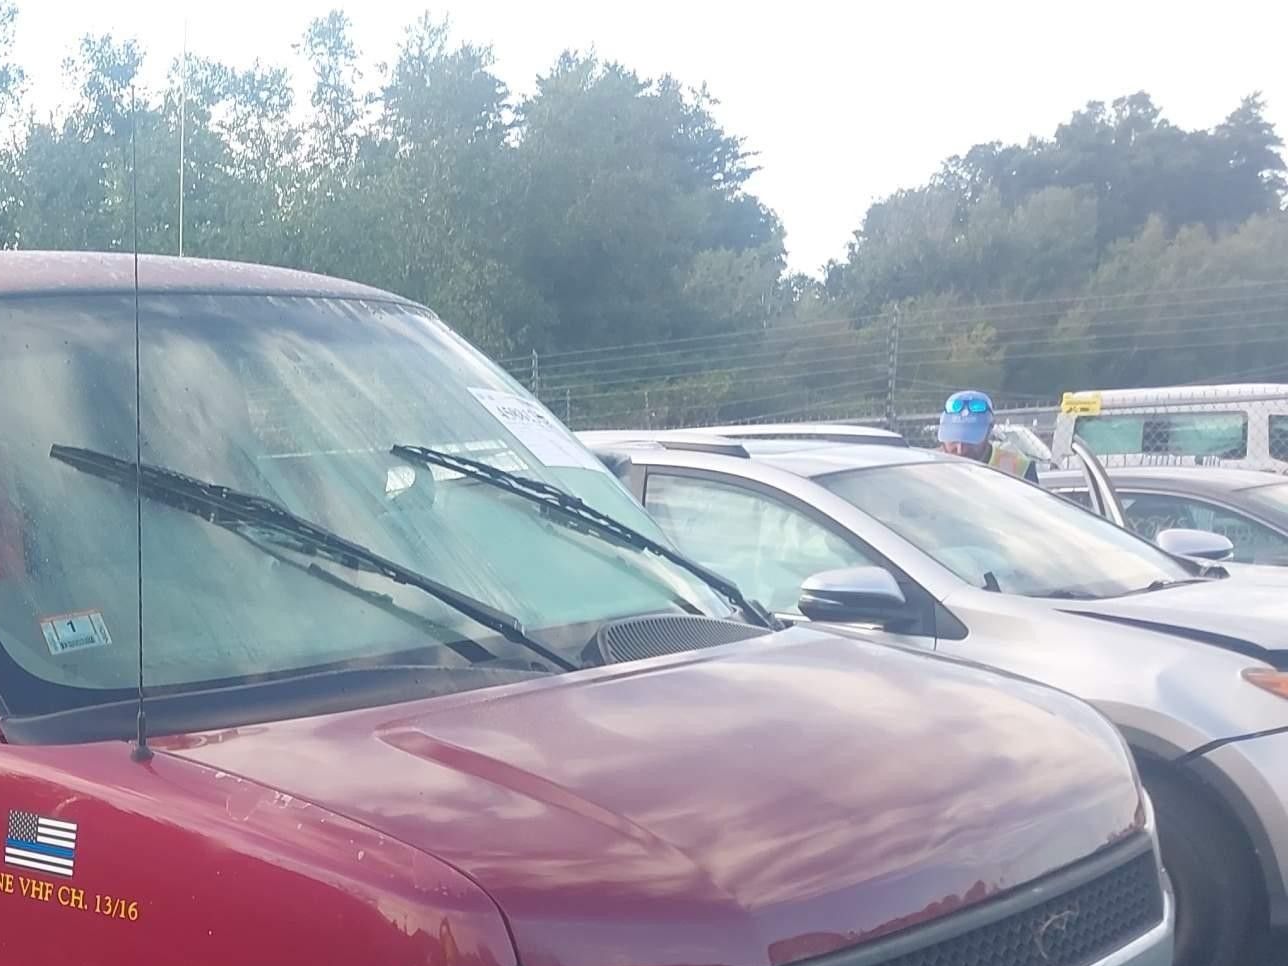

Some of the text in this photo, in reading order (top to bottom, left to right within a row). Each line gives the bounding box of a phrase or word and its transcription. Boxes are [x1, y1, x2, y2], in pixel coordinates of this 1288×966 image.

[18, 877, 54, 902] VHF
[57, 886, 88, 911] CH.
[94, 894, 138, 921] 13/16
